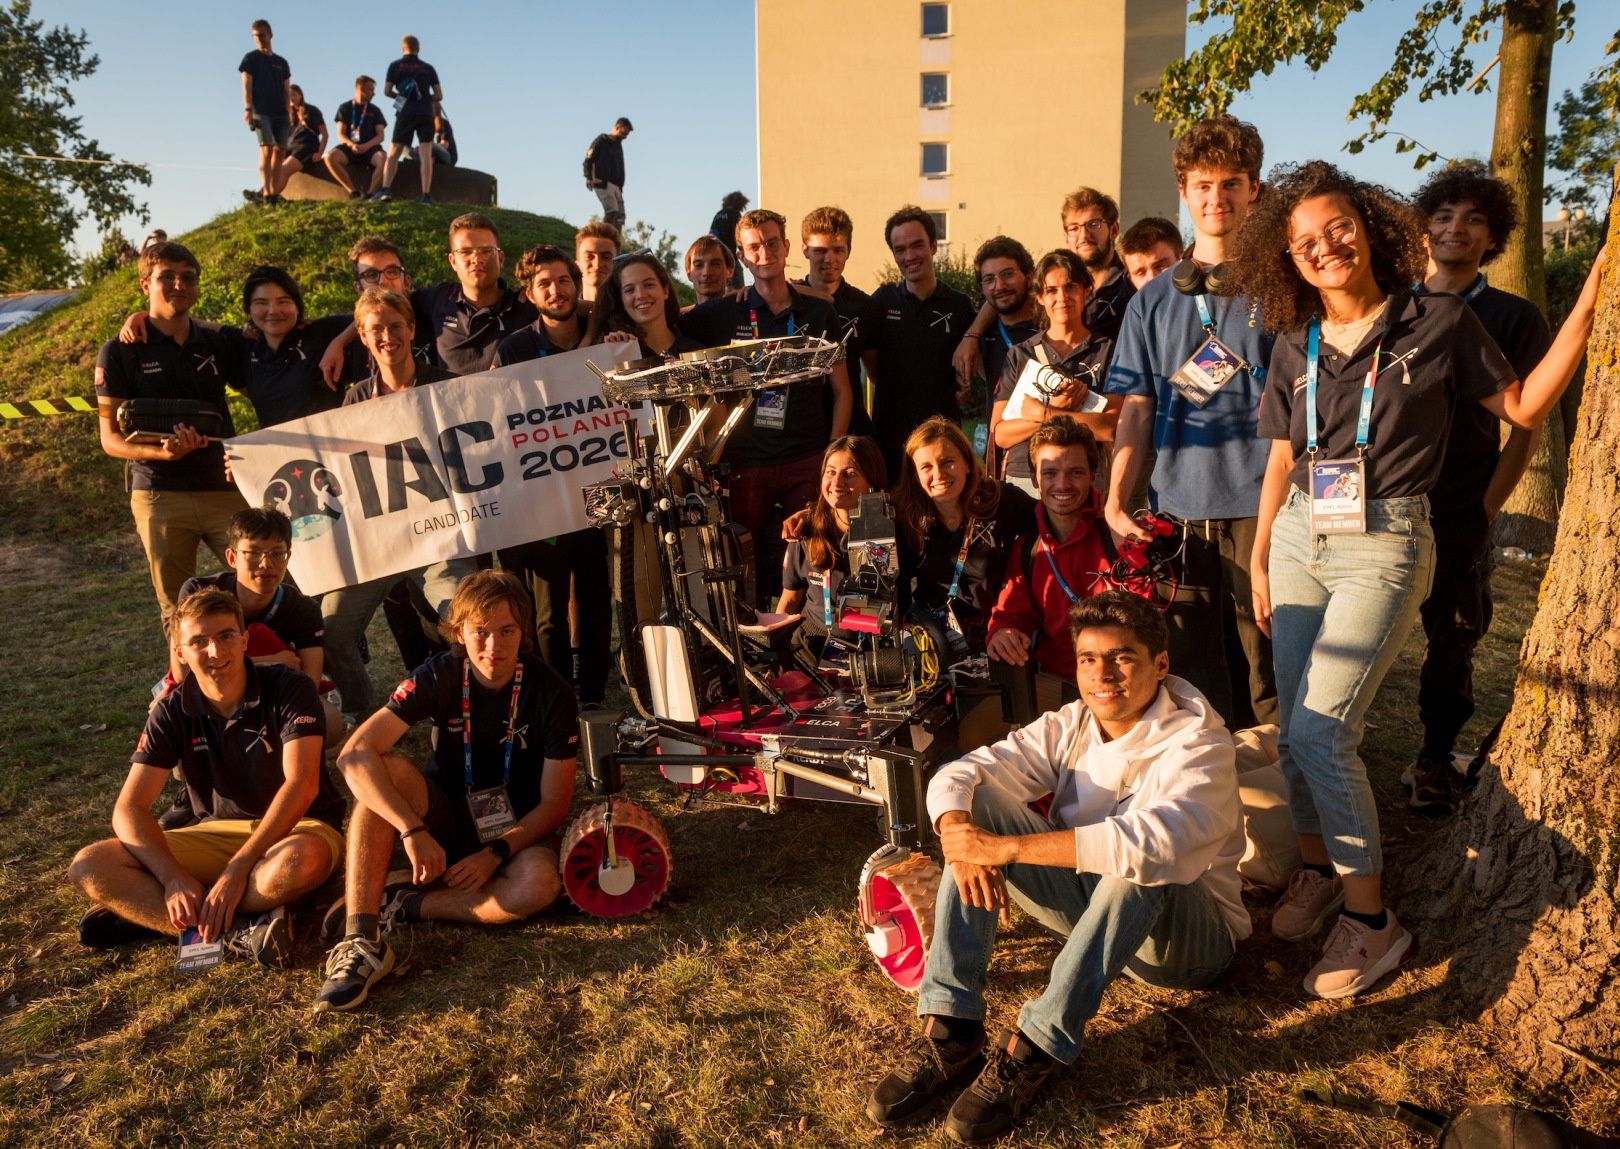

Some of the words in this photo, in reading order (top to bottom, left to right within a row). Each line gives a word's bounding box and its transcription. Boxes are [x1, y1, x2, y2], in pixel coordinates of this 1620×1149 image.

[511, 409, 631, 448] POLAND
[348, 420, 505, 520] IAC
[519, 431, 630, 481] 2026
[413, 501, 502, 535] CANDIDATE
[1333, 519, 1361, 528] MEMBER
[806, 719, 841, 727] ELCA
